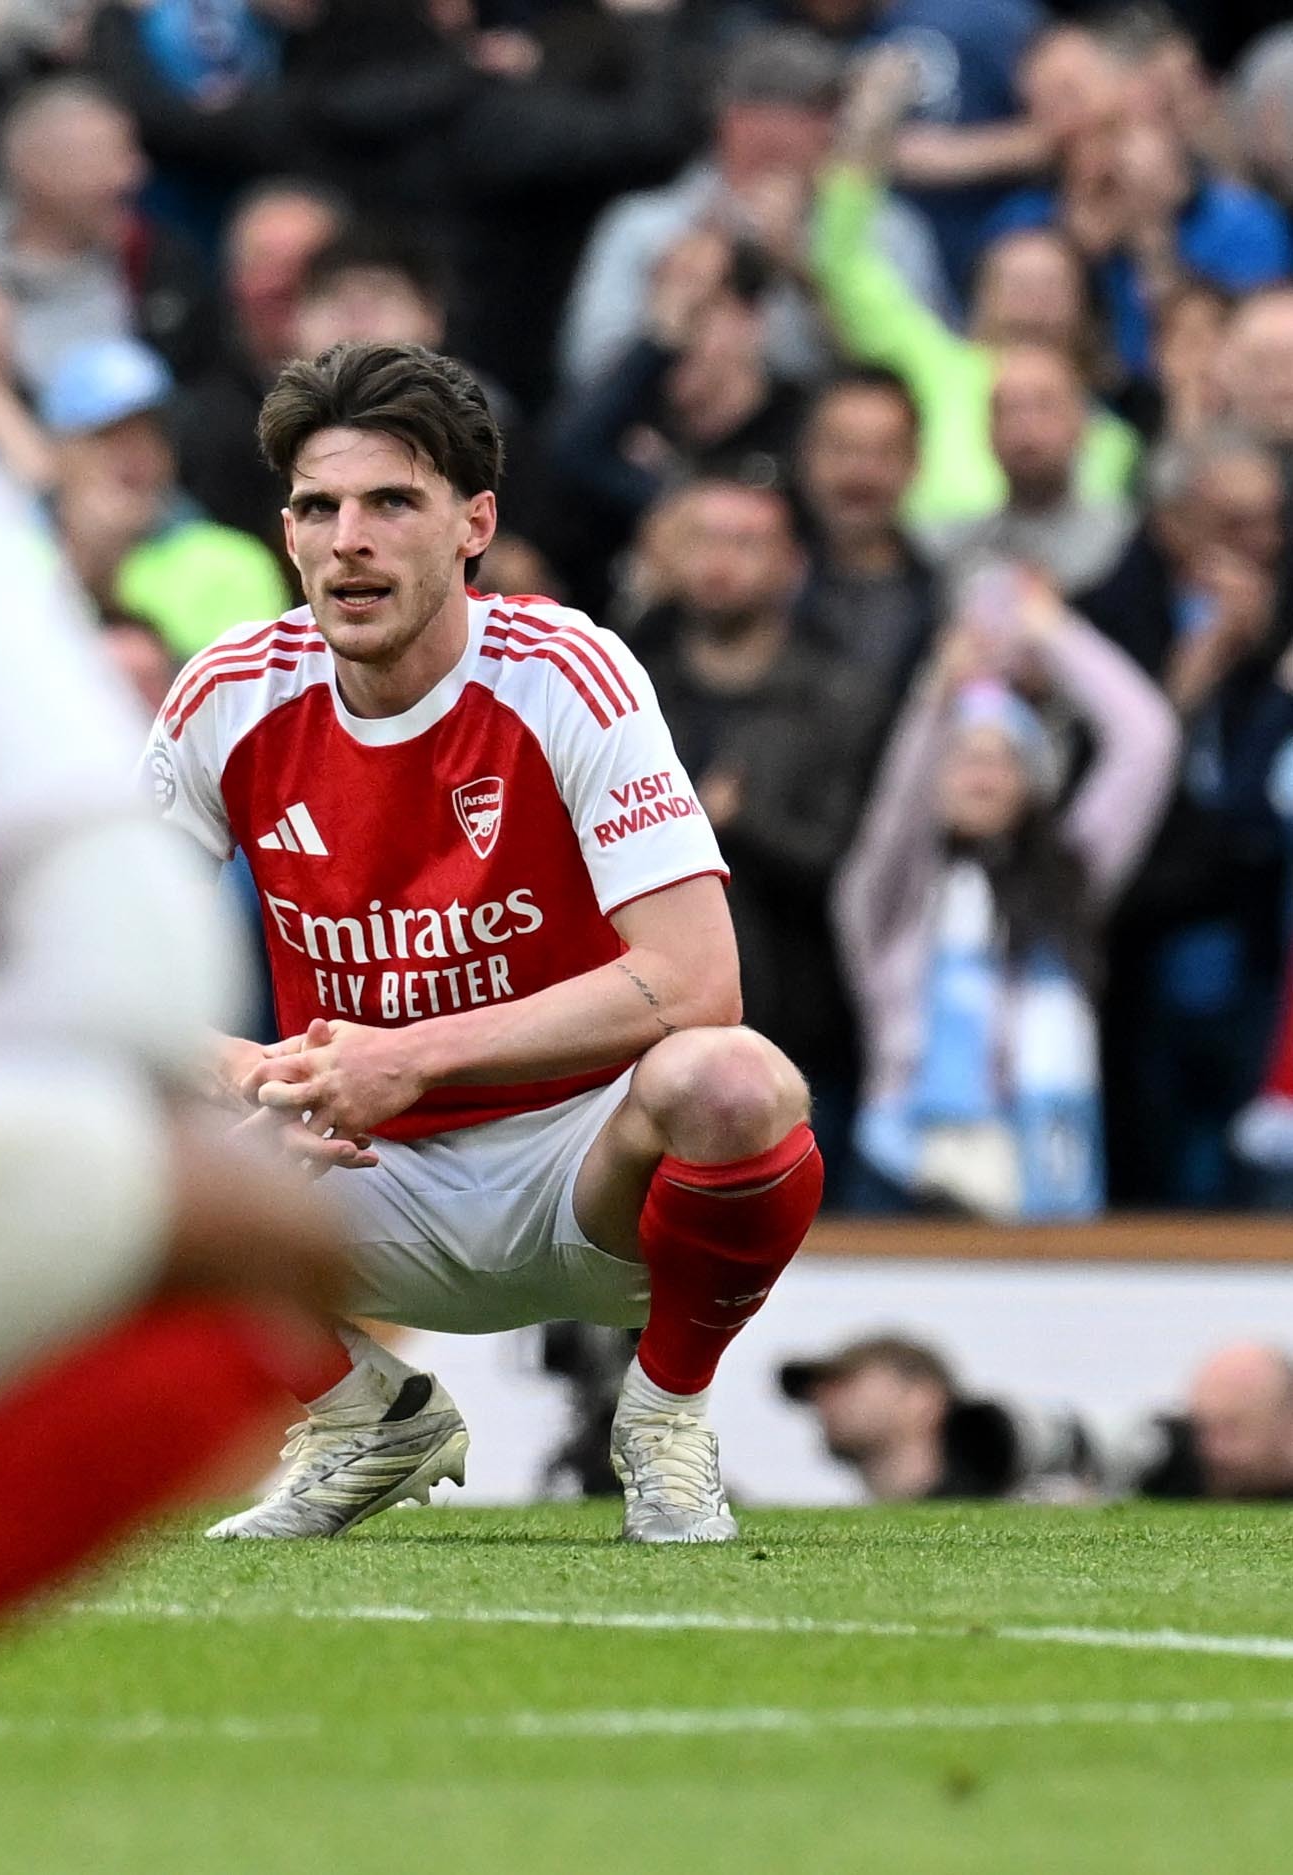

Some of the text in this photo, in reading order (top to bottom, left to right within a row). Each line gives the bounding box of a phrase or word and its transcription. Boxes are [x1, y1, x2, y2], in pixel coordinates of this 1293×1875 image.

[609, 772, 673, 808] VISIT
[594, 795, 702, 848] RWANDA
[264, 888, 544, 964] Emirates
[315, 954, 514, 1019] FLY BETTER
